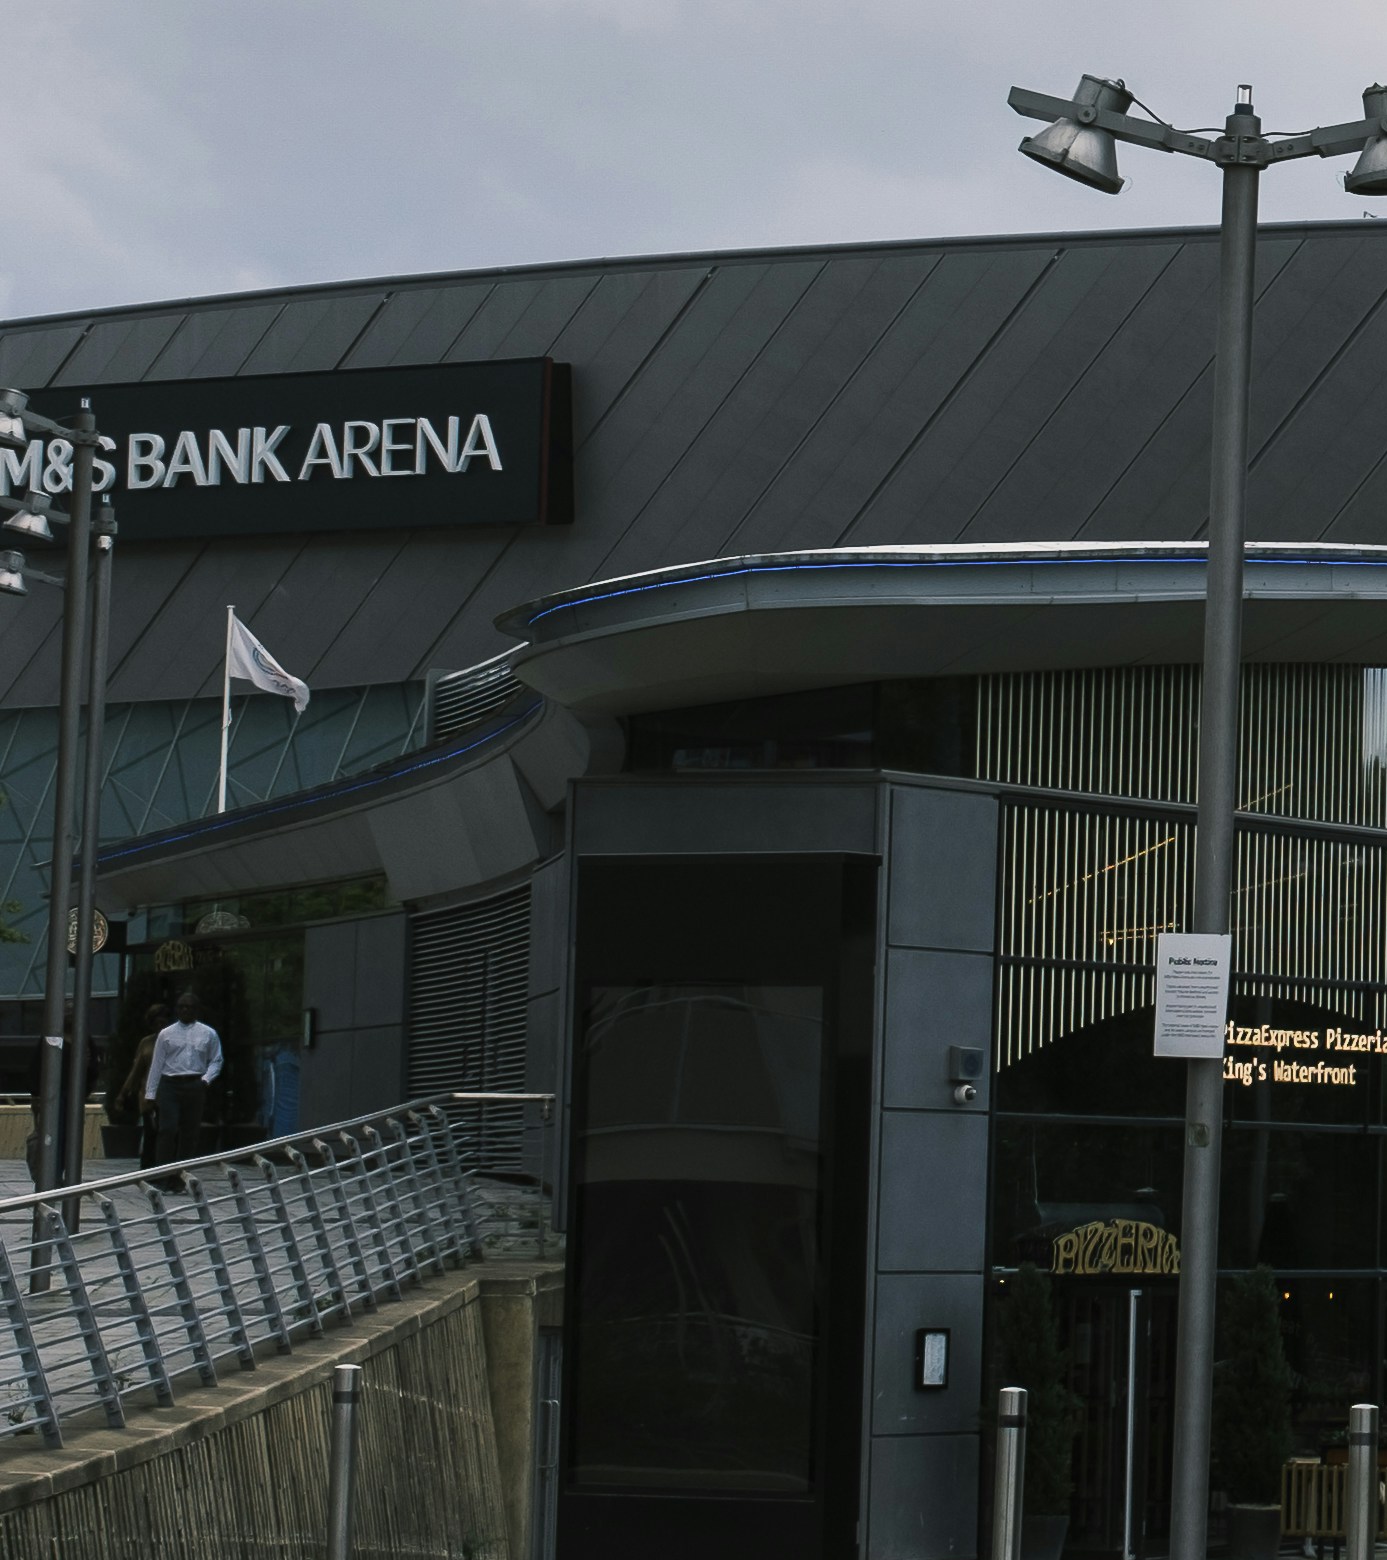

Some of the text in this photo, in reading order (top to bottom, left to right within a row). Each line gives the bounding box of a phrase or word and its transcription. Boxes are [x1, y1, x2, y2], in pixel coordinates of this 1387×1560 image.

[128, 425, 291, 490] BANK
[298, 413, 502, 480] ARENA
[1273, 1060, 1357, 1085] Waterfront
[1051, 1218, 1180, 1274] PIZZERIA
